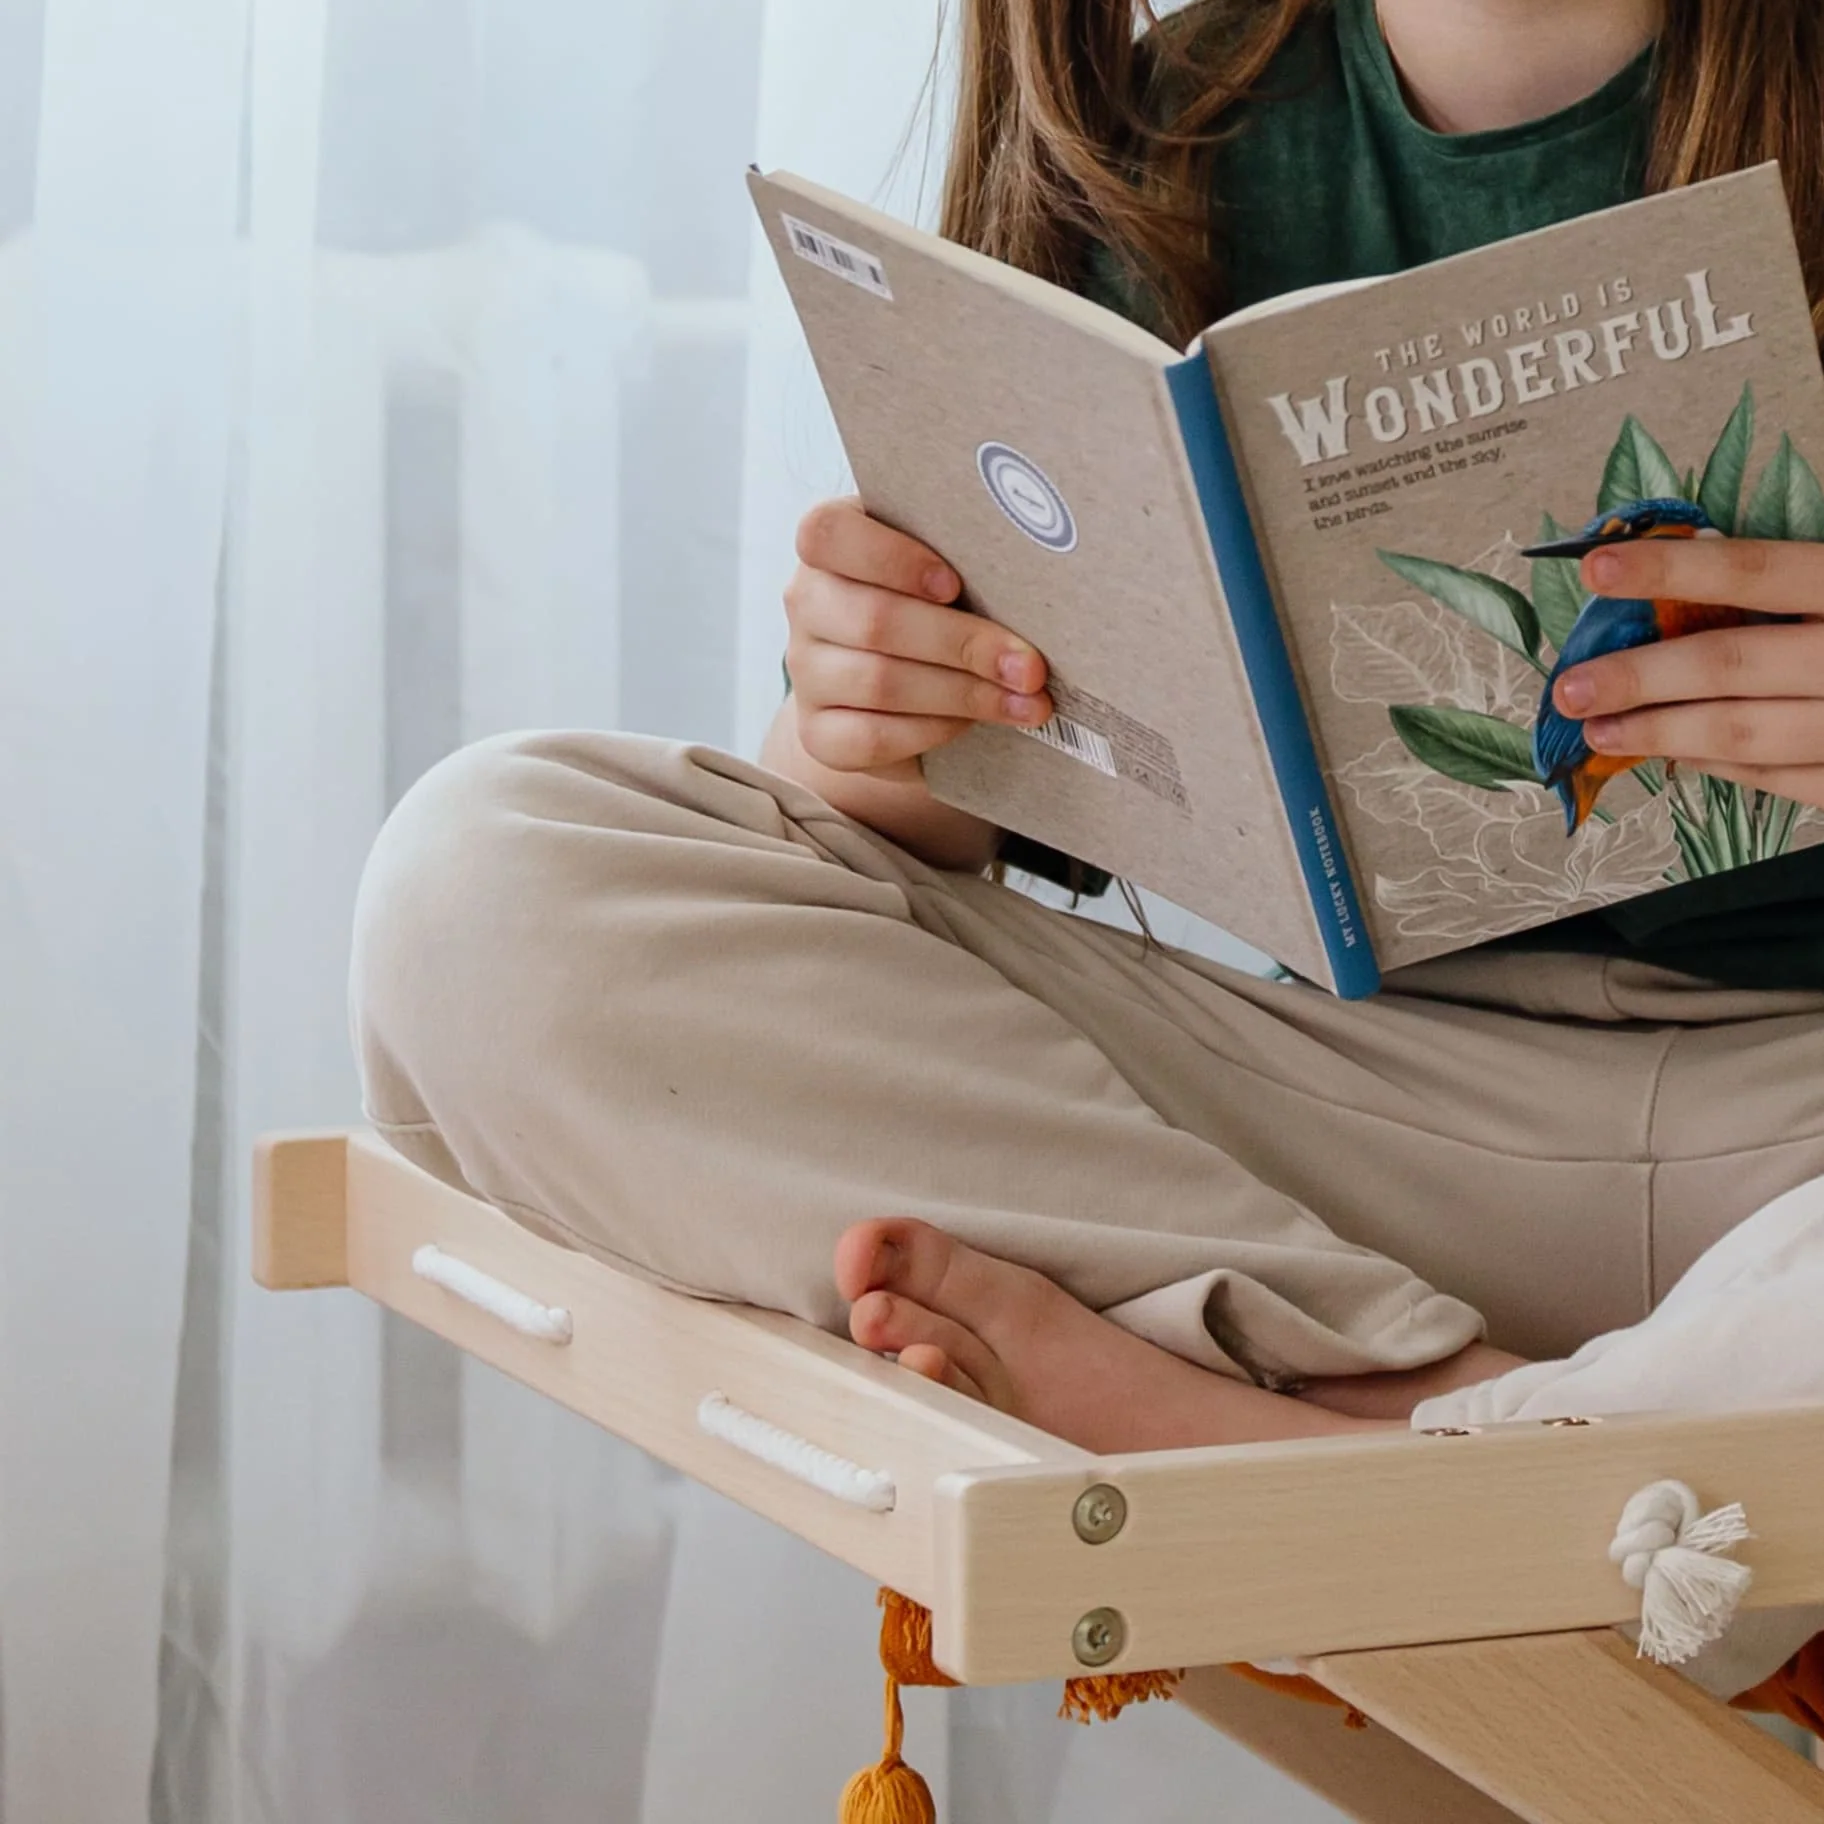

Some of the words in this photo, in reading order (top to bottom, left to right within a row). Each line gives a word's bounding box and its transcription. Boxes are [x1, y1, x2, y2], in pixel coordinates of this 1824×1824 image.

[1375, 334, 1443, 372] THE
[1462, 293, 1581, 347] WORLD
[1598, 276, 1633, 307] IS
[1266, 268, 1757, 467] WONDERFUL
[1303, 477, 1315, 493] I
[1319, 468, 1351, 488] love
[1354, 444, 1432, 477] watching
[1435, 436, 1464, 455] the
[1467, 418, 1528, 445] sunrise
[1308, 493, 1341, 512] and
[1345, 476, 1399, 501] sunset
[1403, 465, 1436, 486] and
[1438, 456, 1468, 474] the
[1313, 513, 1342, 531] the
[1309, 805, 1337, 878] NOTEBOOK
[1329, 881, 1350, 924] LUCKY
[1342, 926, 1356, 948] MY
